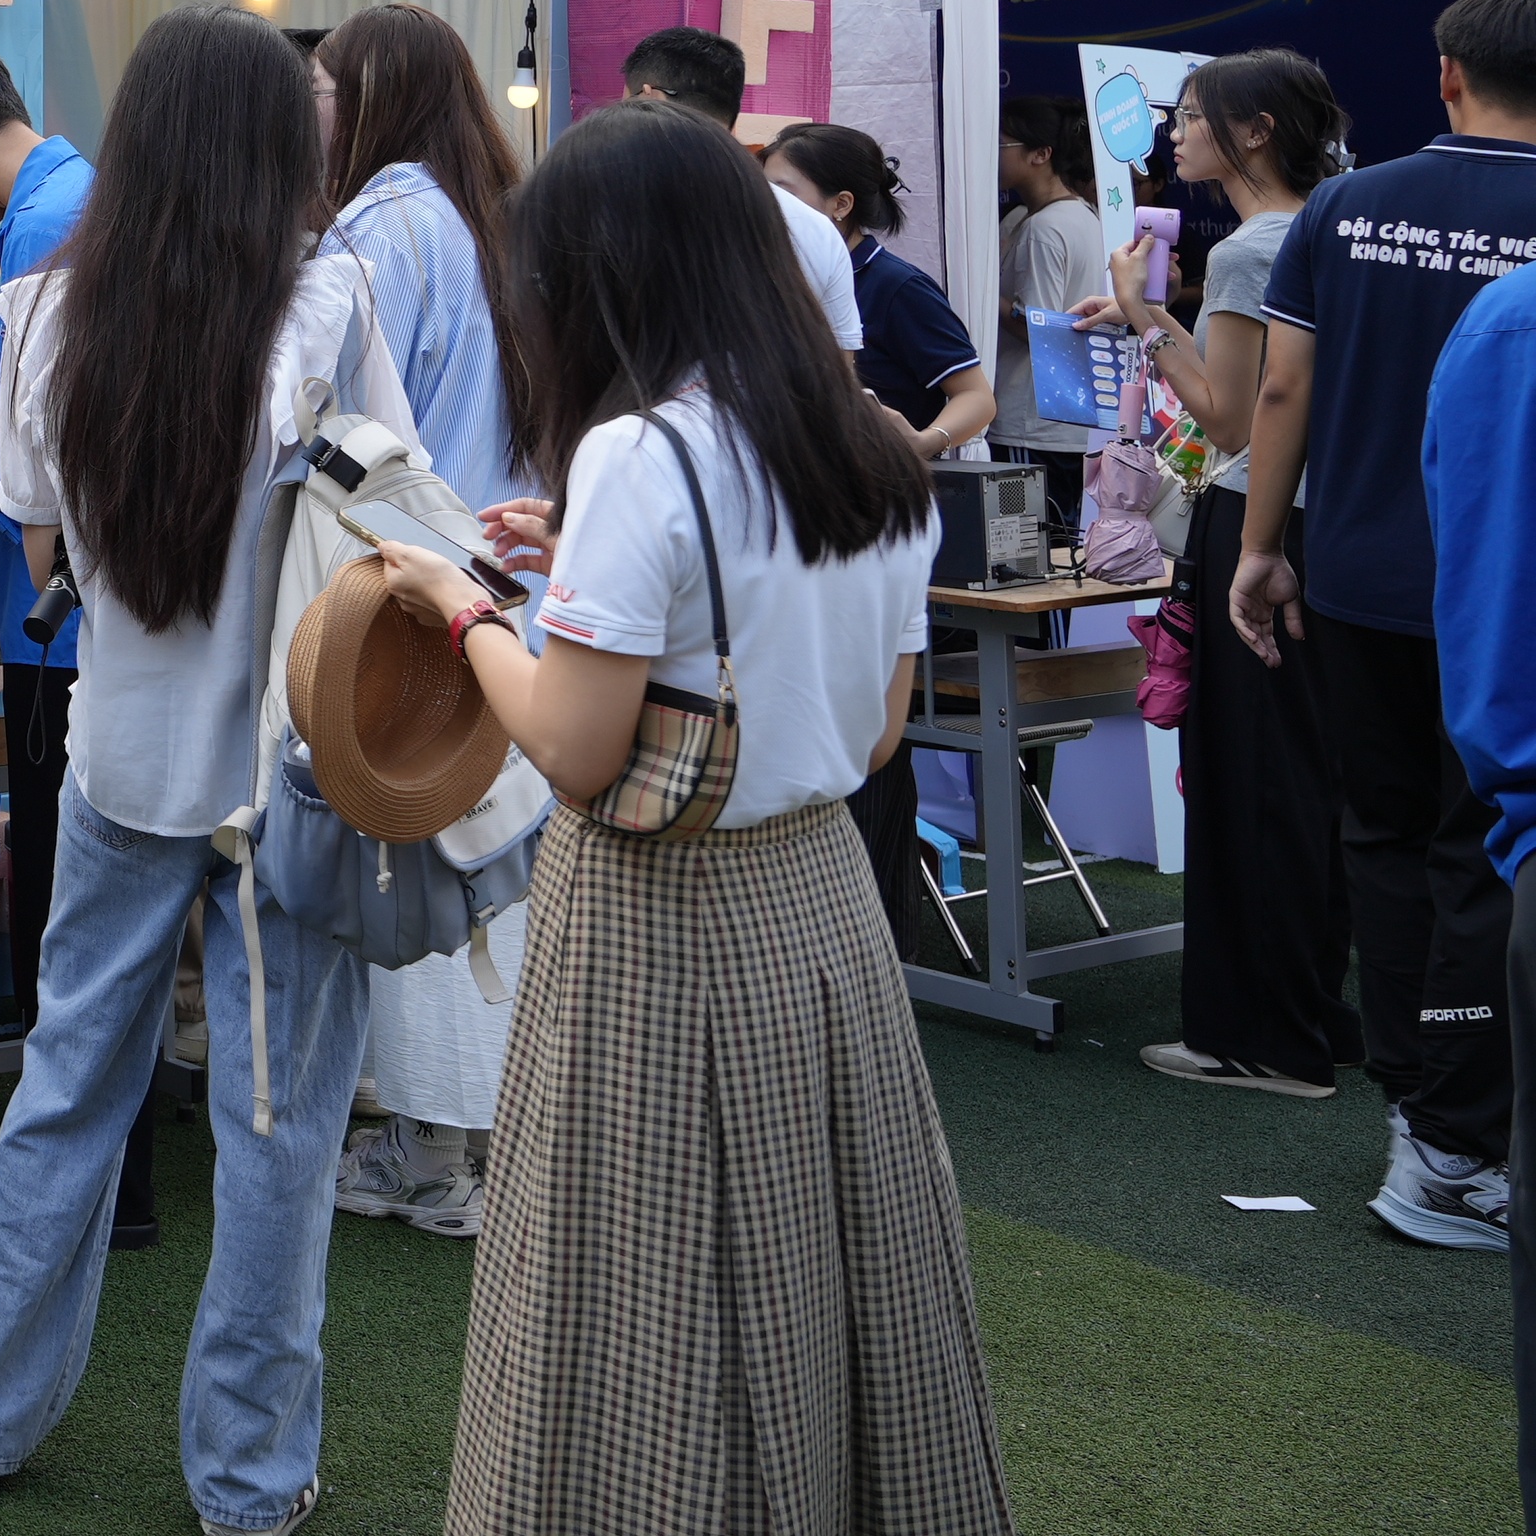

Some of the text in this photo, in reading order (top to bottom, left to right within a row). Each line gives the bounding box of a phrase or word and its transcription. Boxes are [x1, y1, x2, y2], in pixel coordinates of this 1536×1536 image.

[1336, 216, 1536, 260] ĐỘI CỘNG TÁC VIÊ
[1349, 241, 1524, 278] KHOA TÀI CHÍN
[465, 798, 494, 820] BRAVE
